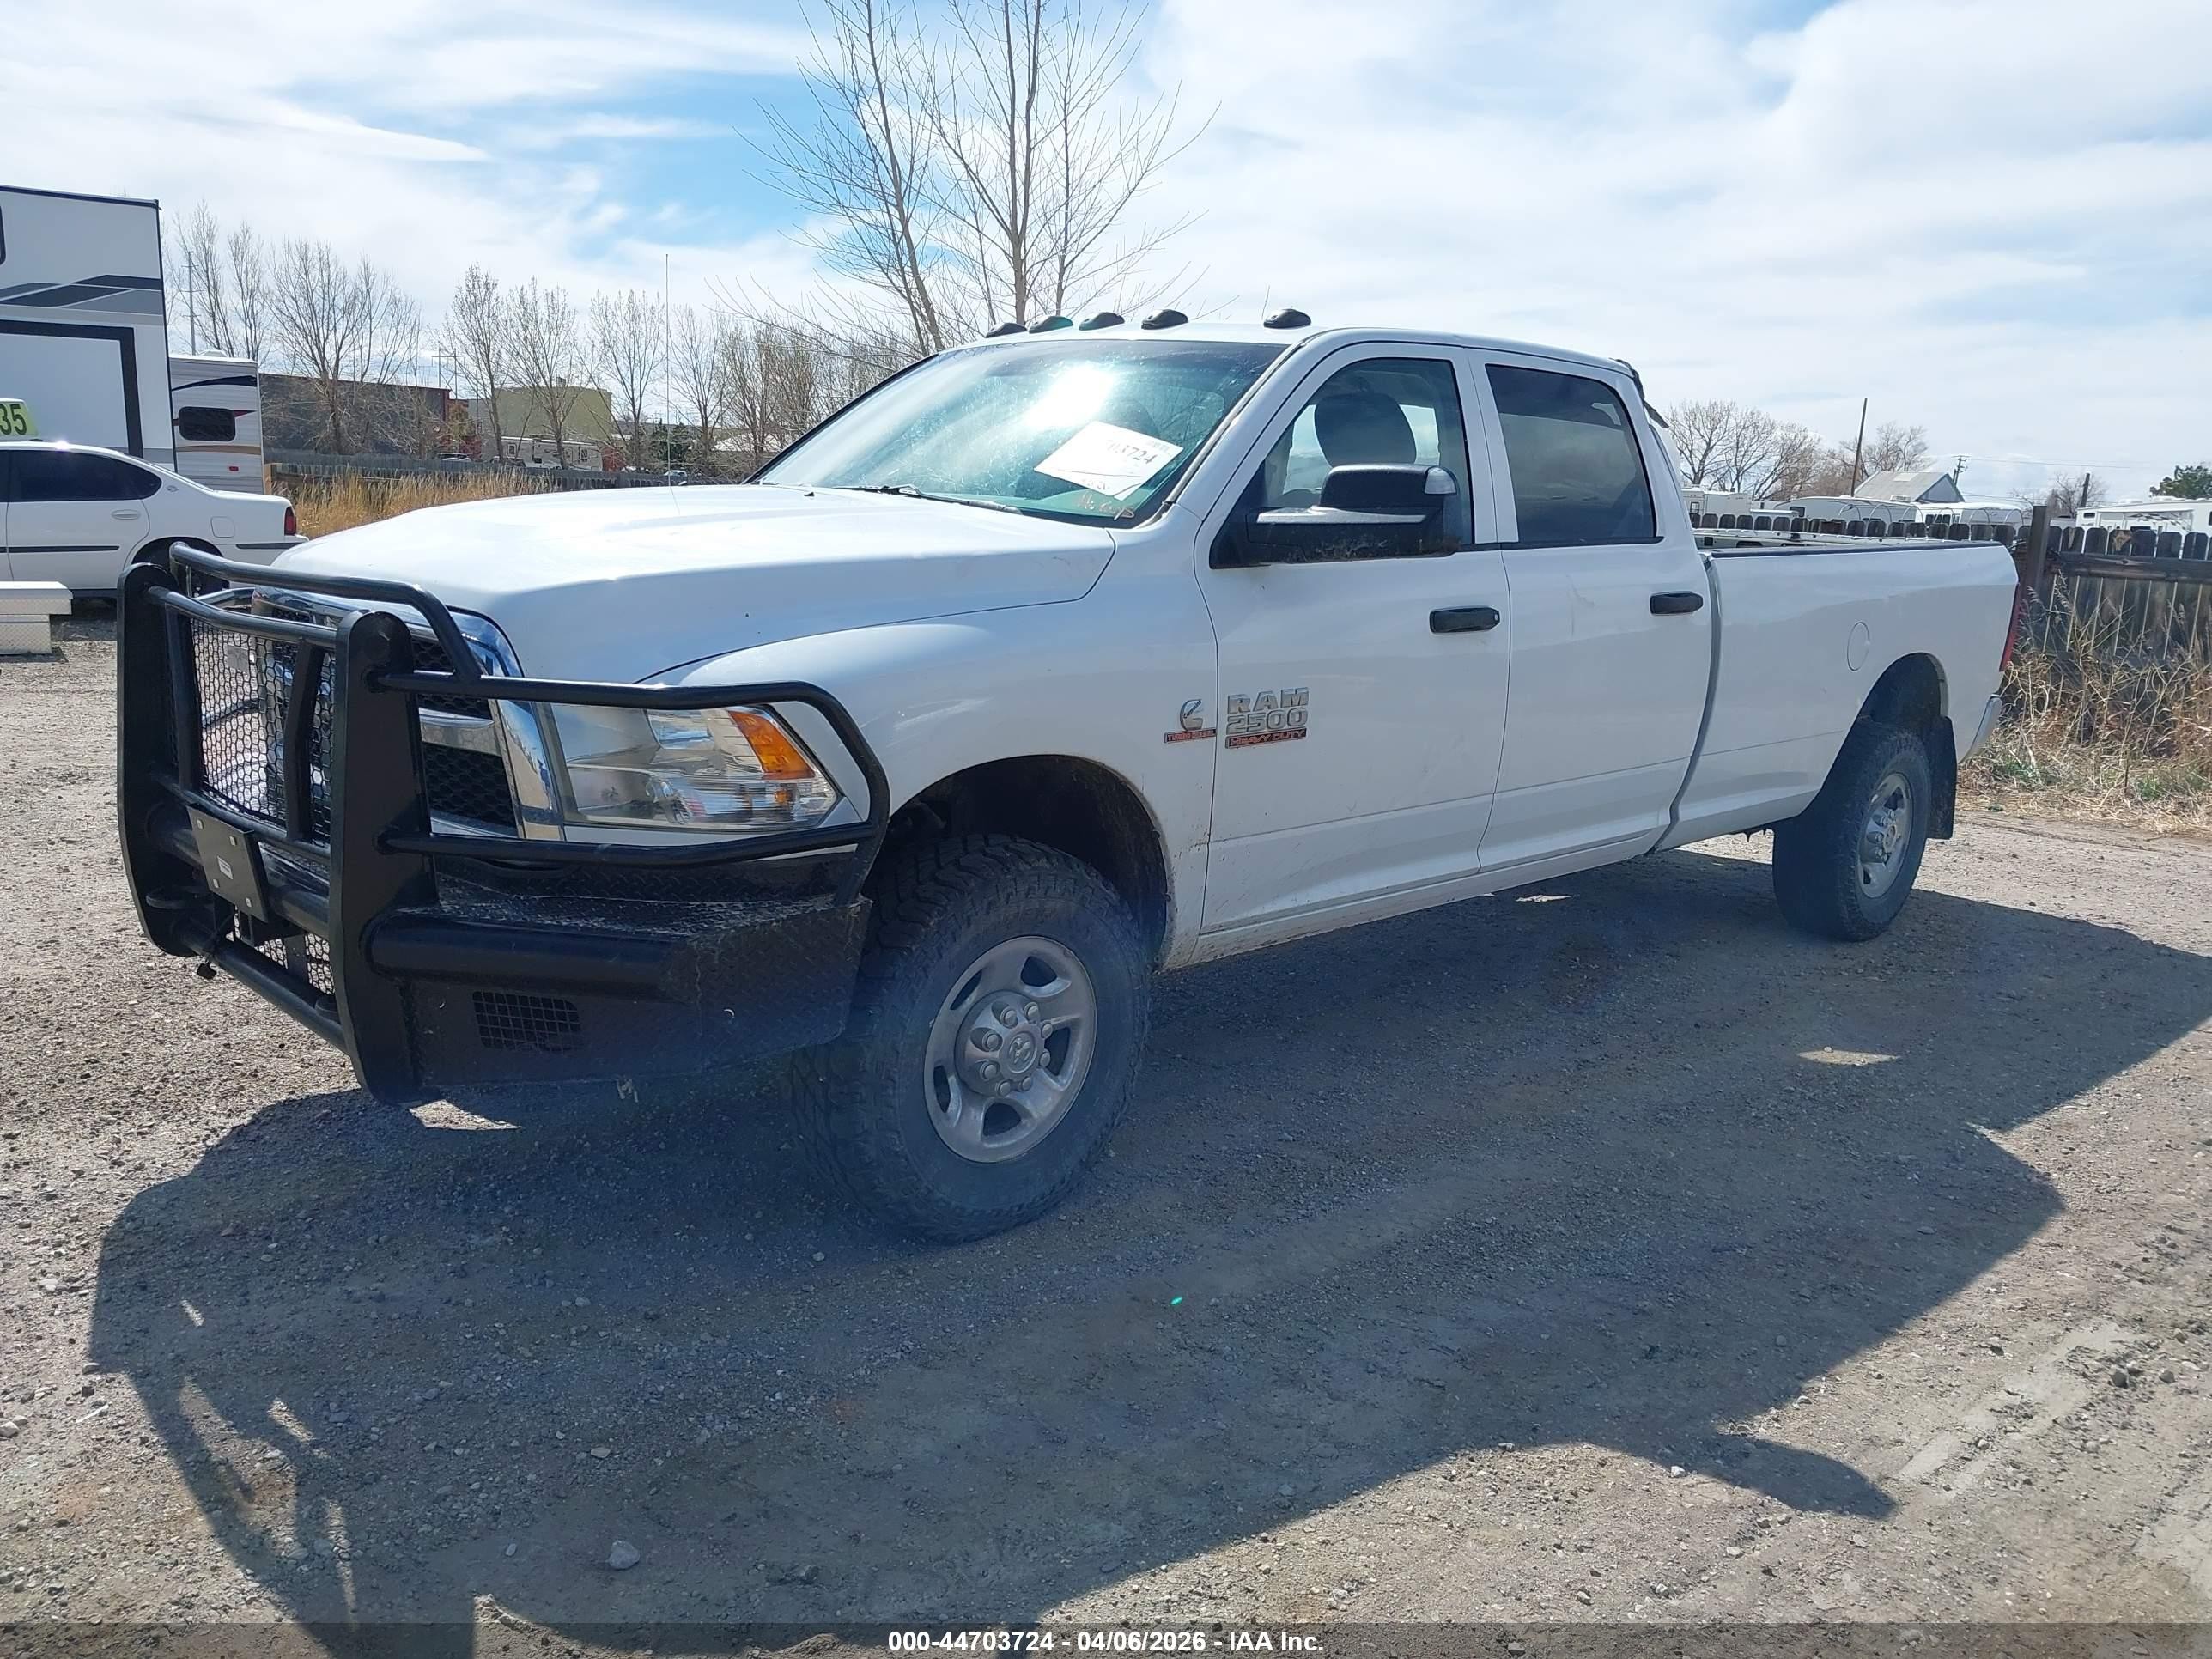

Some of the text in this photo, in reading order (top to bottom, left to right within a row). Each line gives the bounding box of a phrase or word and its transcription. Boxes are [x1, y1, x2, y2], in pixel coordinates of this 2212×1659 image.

[1227, 687, 1310, 714] RAM
[1226, 708, 1308, 735] 2500
[1230, 730, 1305, 746] HEAVY DUTY
